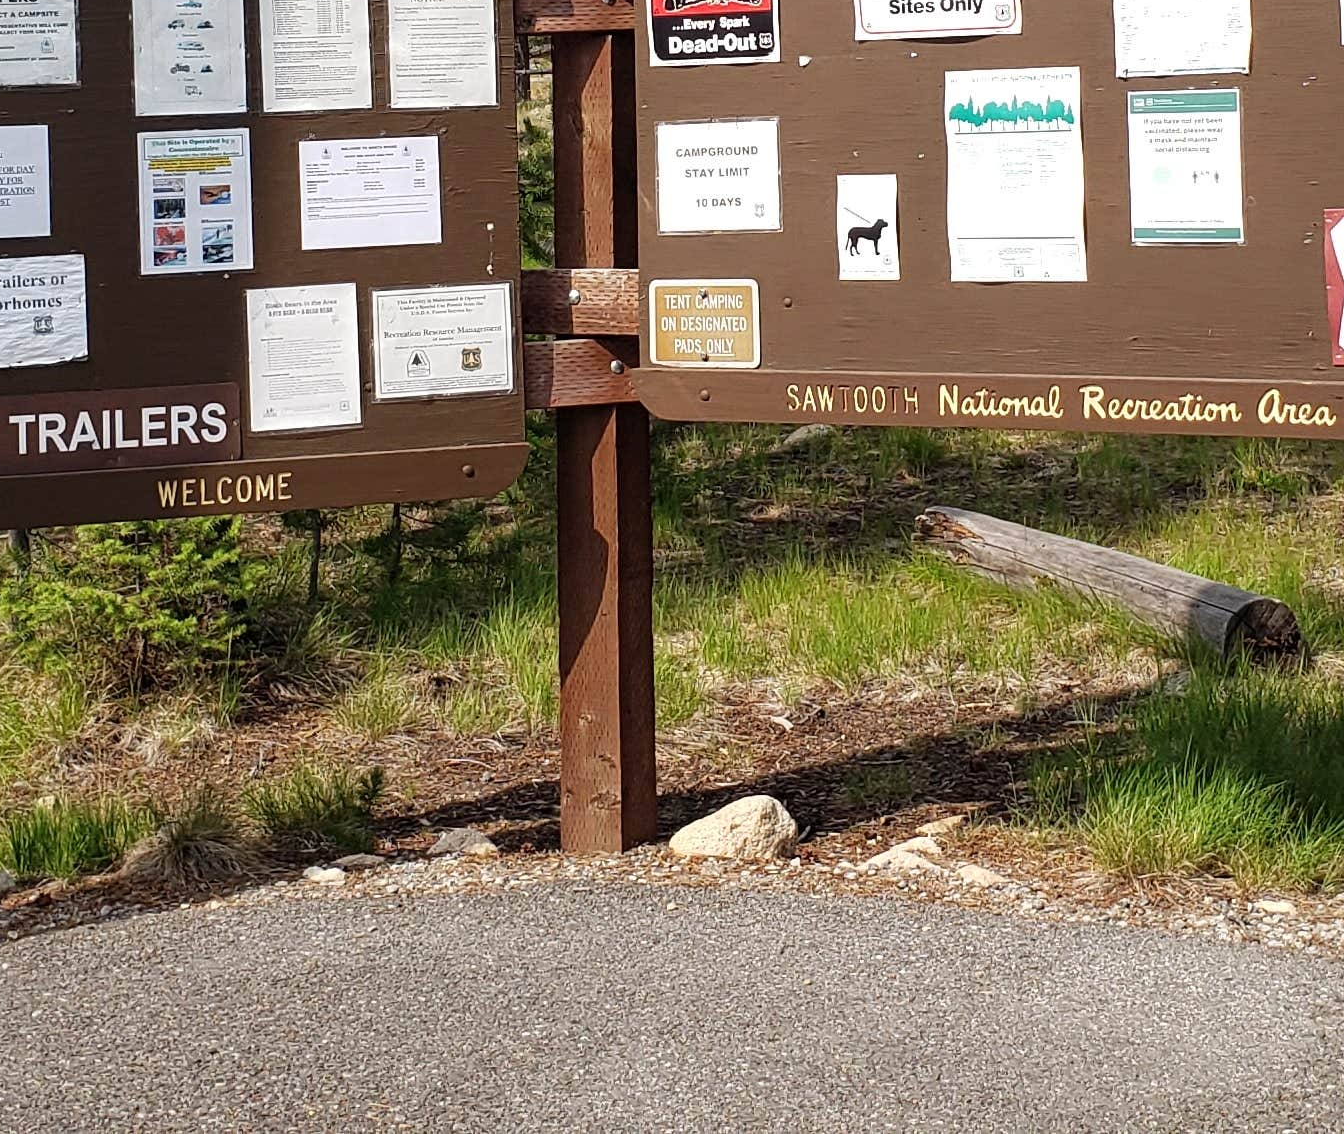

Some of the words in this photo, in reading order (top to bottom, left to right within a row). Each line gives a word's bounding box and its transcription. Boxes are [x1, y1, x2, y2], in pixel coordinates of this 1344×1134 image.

[889, 0, 935, 14] Sites
[720, 16, 750, 29] Spark
[668, 33, 757, 54] Dead-Out
[676, 146, 758, 157] CAMPGROUND
[0, 166, 16, 174] FOR
[17, 166, 35, 174] DAY
[685, 169, 714, 178] STAY
[719, 168, 749, 177] LIMIT
[696, 198, 708, 207] 10
[712, 198, 741, 207] DAYS
[51, 275, 68, 285] or
[664, 295, 691, 309] TENT
[695, 294, 743, 309] CAMPING
[661, 317, 676, 331] ON
[680, 316, 746, 331] DESIGNATED
[384, 330, 421, 338] Recreation
[674, 339, 701, 354] PADS
[707, 338, 734, 354] ONLY
[786, 384, 919, 414] SAWTOOTH
[938, 384, 1064, 418] National
[1078, 385, 1242, 422] Recreation
[1258, 388, 1336, 426] Area
[9, 402, 227, 455] TRAILERS
[158, 472, 293, 507] WELCOME
